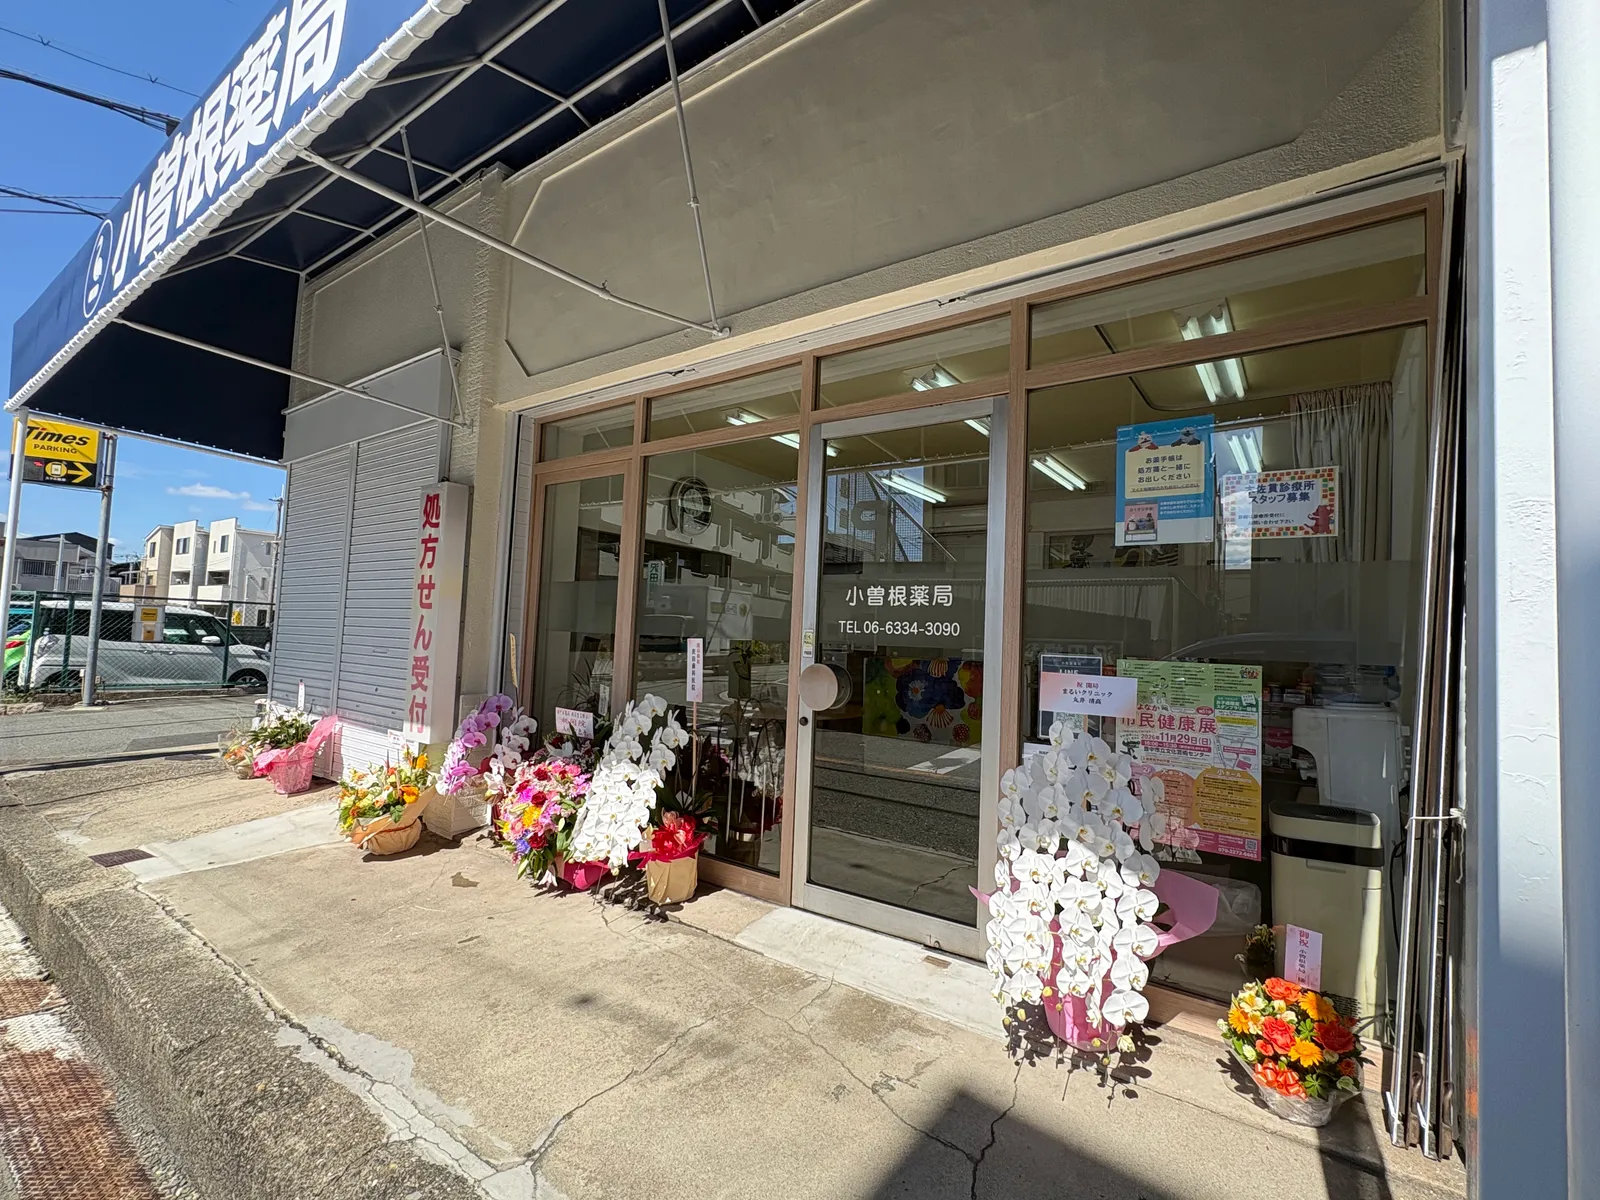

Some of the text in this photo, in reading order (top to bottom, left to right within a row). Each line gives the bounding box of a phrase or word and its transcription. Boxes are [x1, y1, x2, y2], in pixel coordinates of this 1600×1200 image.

[111, 0, 347, 292] 小曽根薬局
[26, 426, 91, 446] Times
[33, 443, 78, 454] PARKING
[1145, 454, 1183, 464] お薬手帳は
[1137, 463, 1191, 474] 処方箋と一緒に
[1137, 473, 1191, 483] お出しください
[1249, 491, 1311, 505] スタッフ募集
[845, 584, 953, 607] 小曽根薬局
[408, 493, 441, 734] 処方せん受付
[838, 620, 961, 637] TEL 06-6334-3090
[1062, 688, 1113, 698] まるいクリニック
[1122, 711, 1218, 735] 市民健康展
[1216, 769, 1242, 778] 小ホール
